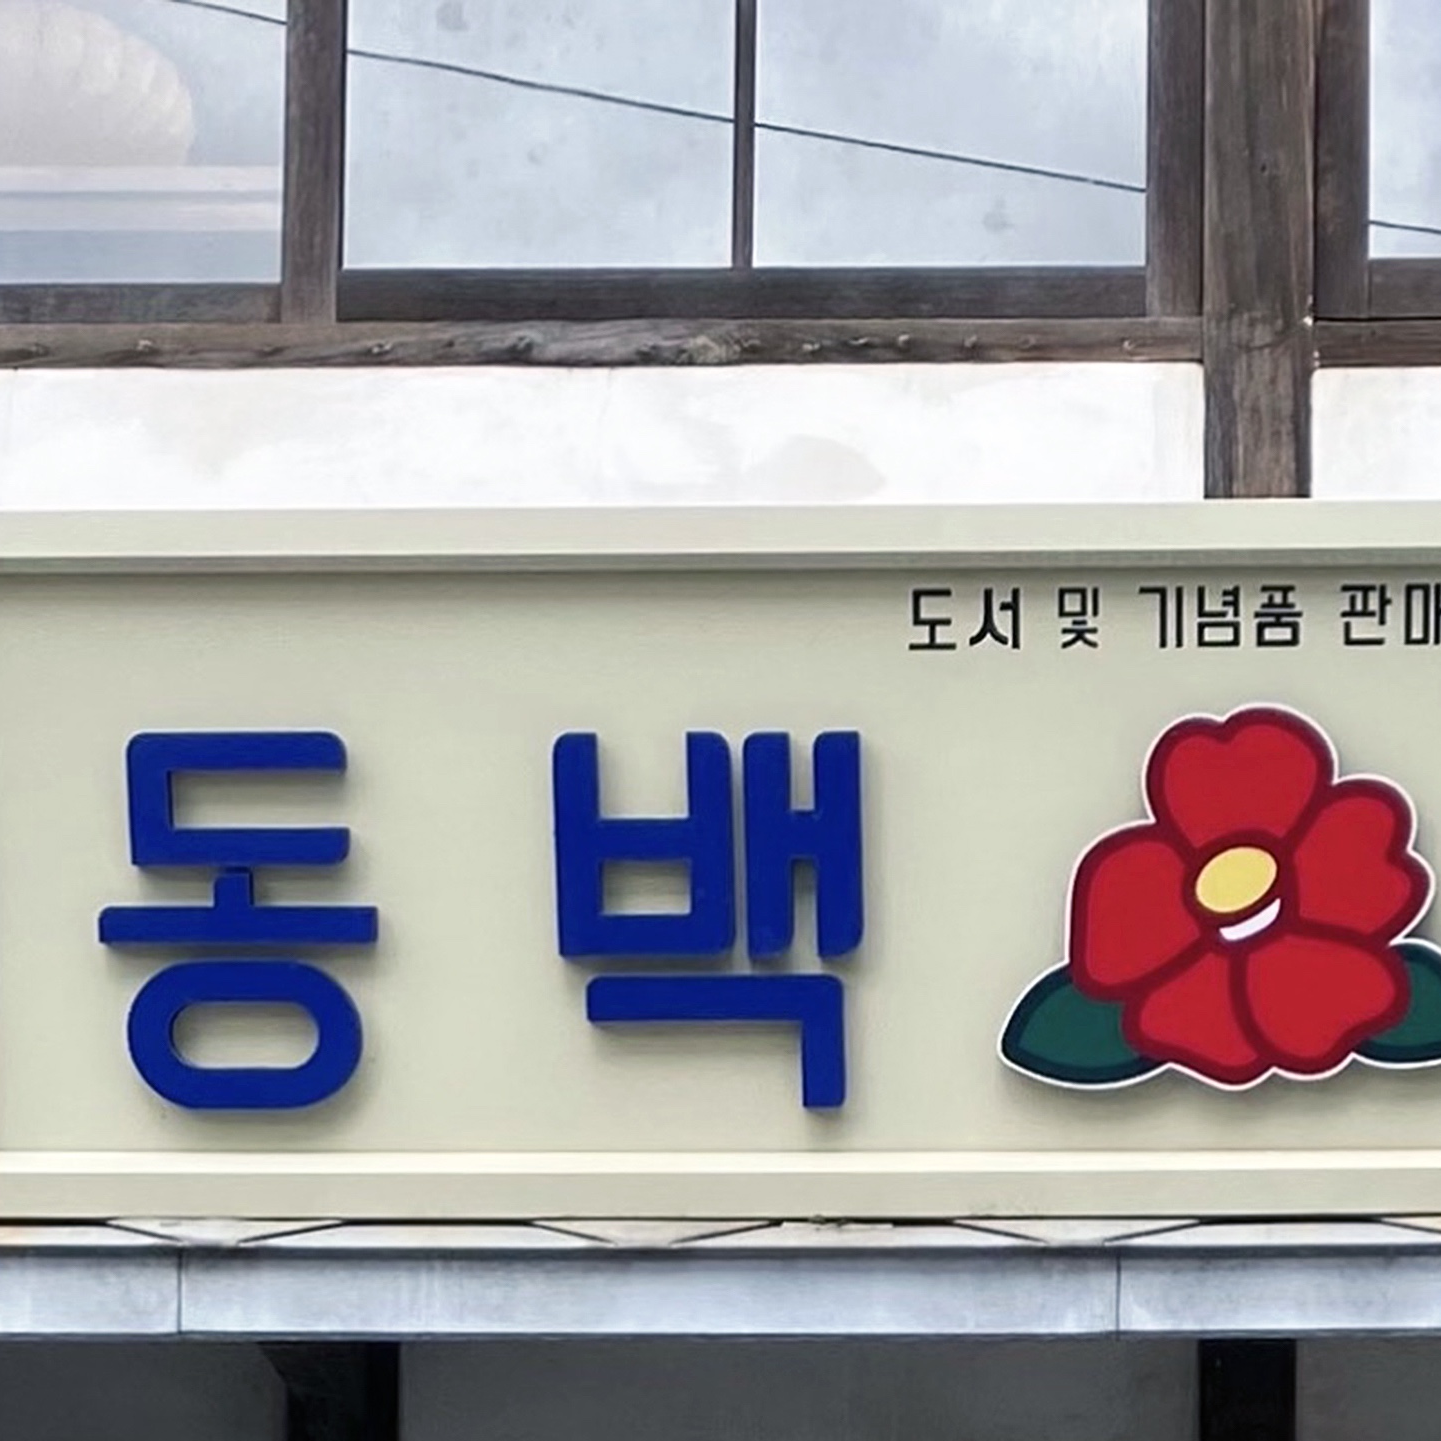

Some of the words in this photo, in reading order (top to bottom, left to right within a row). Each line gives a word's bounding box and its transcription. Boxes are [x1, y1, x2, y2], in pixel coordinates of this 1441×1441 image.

[909, 585, 1022, 651] 도서
[1057, 586, 1100, 649] 및
[1138, 584, 1303, 649] 기념품
[97, 728, 864, 1112] 동백
